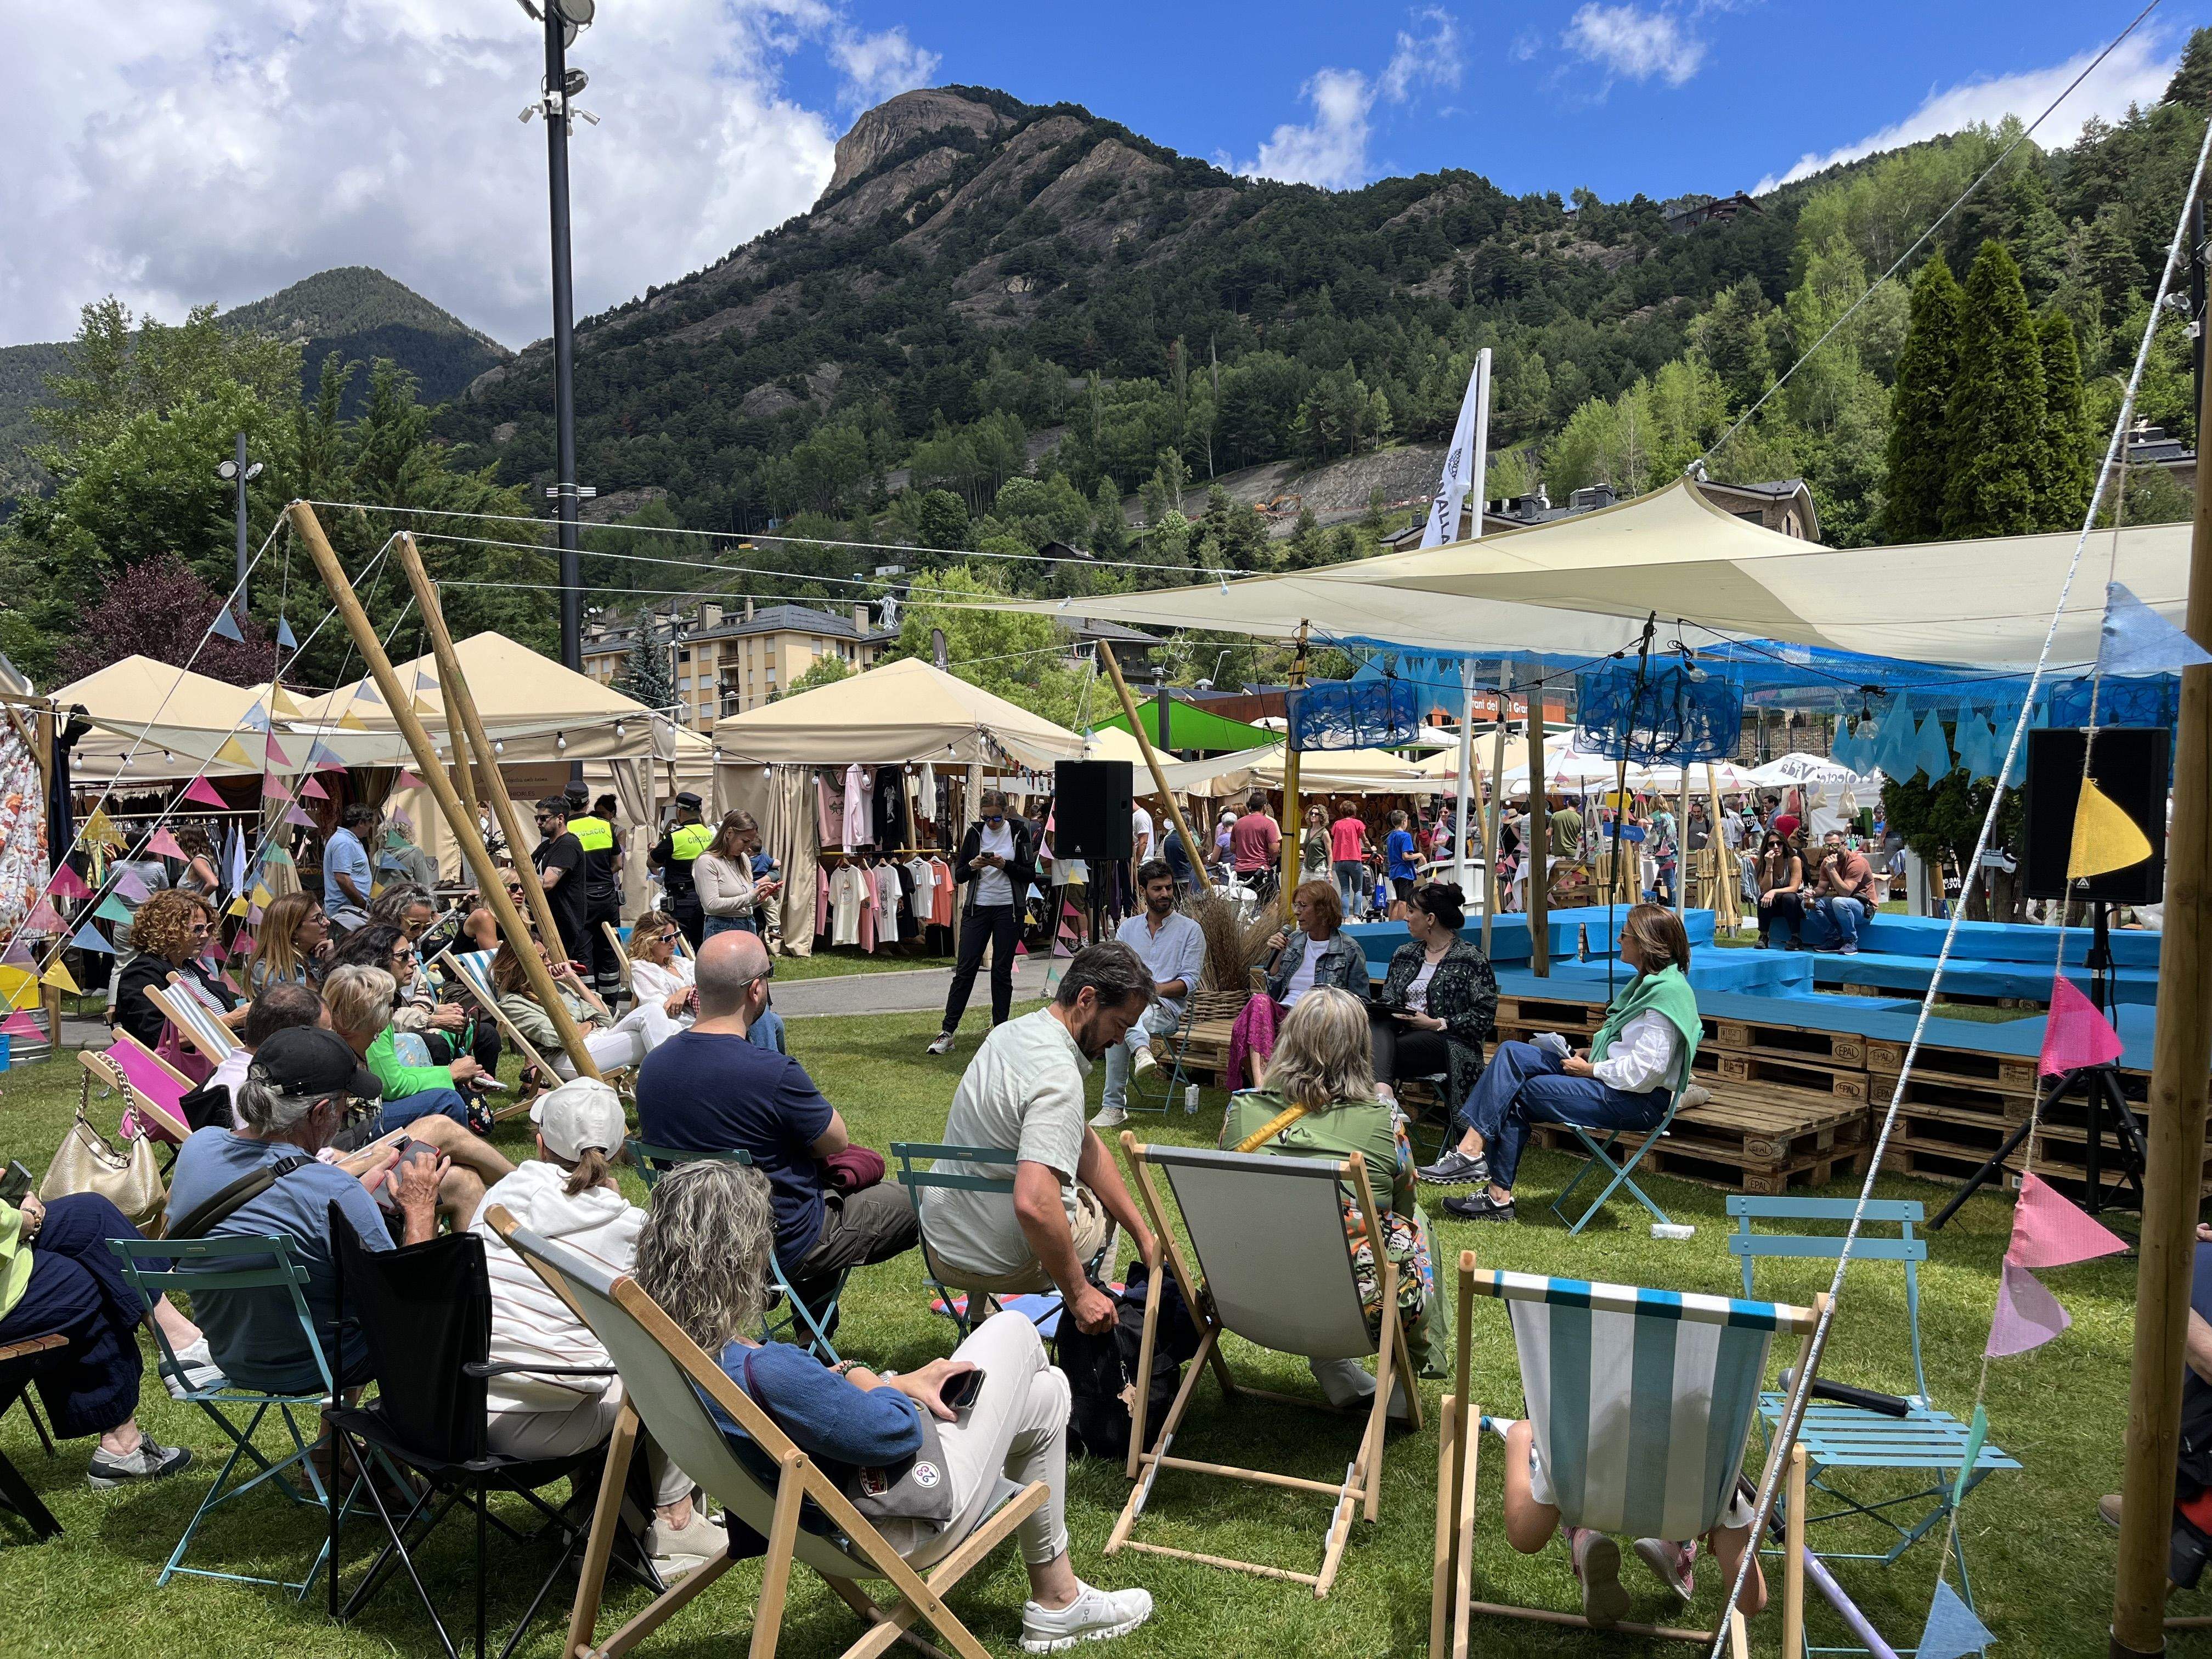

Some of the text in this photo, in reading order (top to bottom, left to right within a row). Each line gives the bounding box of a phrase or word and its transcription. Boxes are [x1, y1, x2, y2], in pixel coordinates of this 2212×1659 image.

[1487, 700, 1498, 712] del
[1839, 1046, 1855, 1058] EPAL
[1873, 1052, 1891, 1062] EPAL
[1839, 1084, 1855, 1097] EPAL
[1751, 1180, 1768, 1192] EPAL
